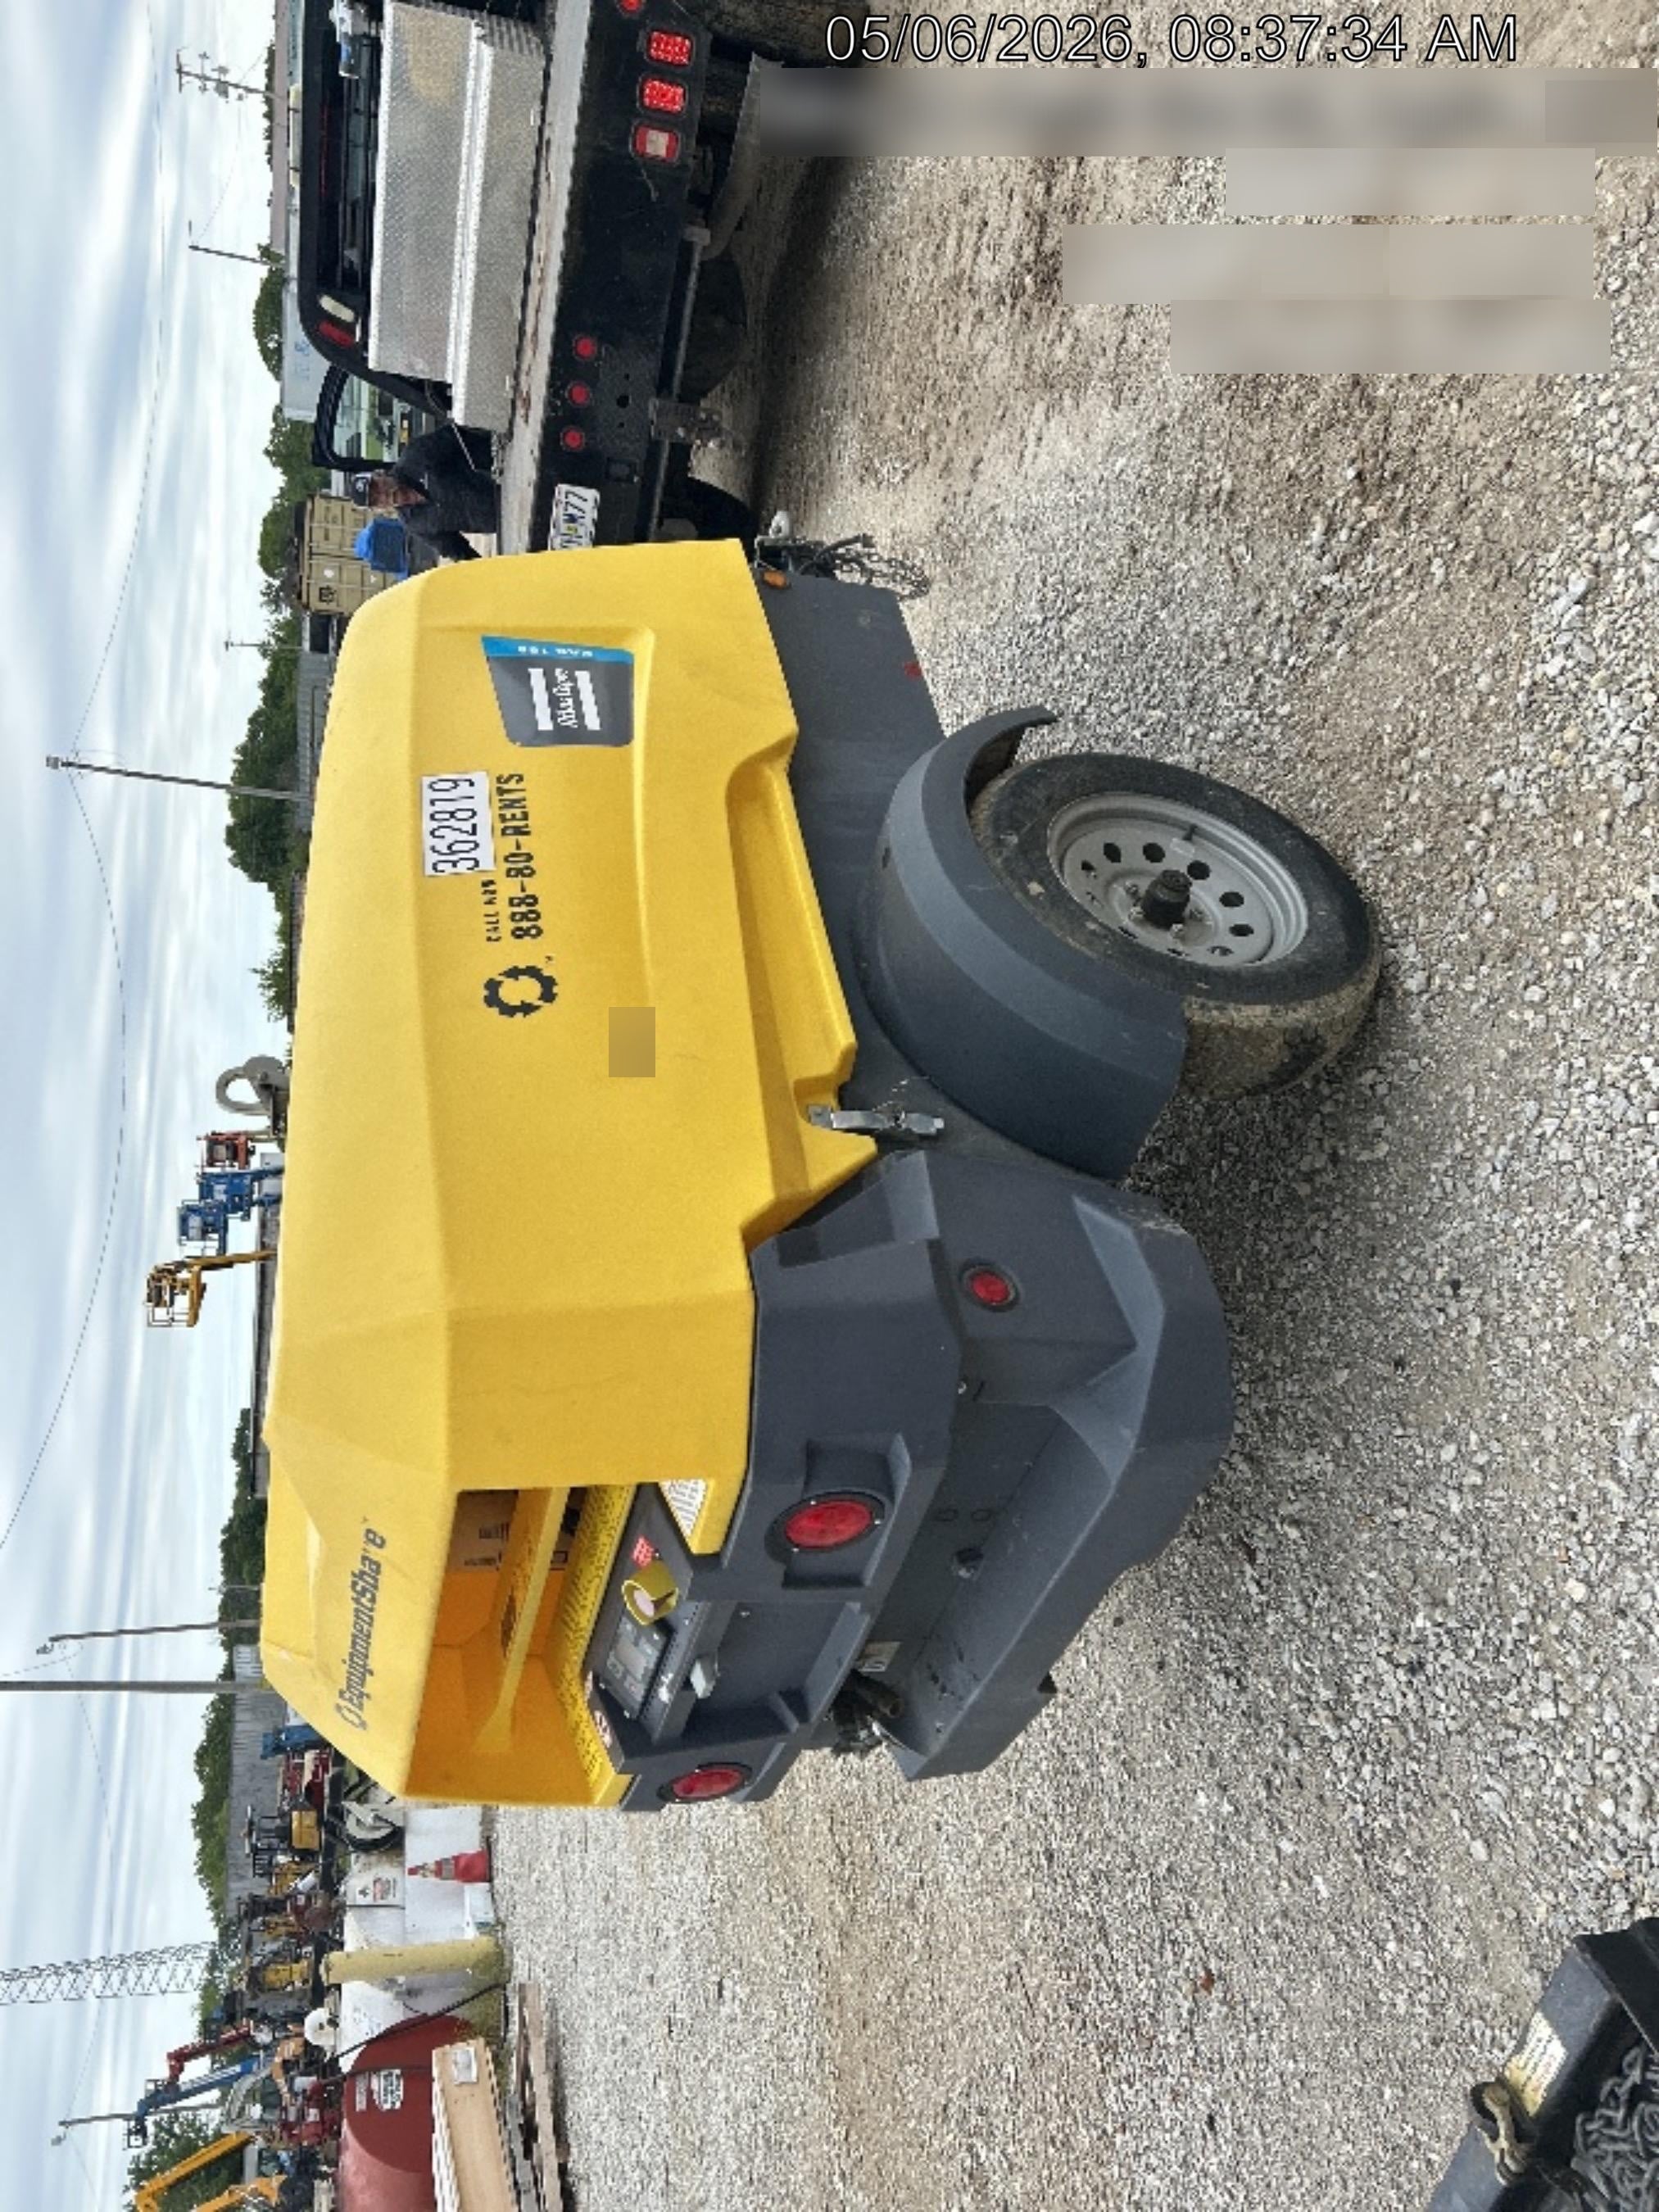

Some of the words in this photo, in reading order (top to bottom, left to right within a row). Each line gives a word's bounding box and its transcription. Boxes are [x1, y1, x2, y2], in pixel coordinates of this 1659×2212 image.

[428, 778, 480, 873] 362819
[496, 773, 544, 940] 888-80-RENTS
[483, 911, 502, 943] CALL
[338, 1528, 387, 1712] EquipmentShae
